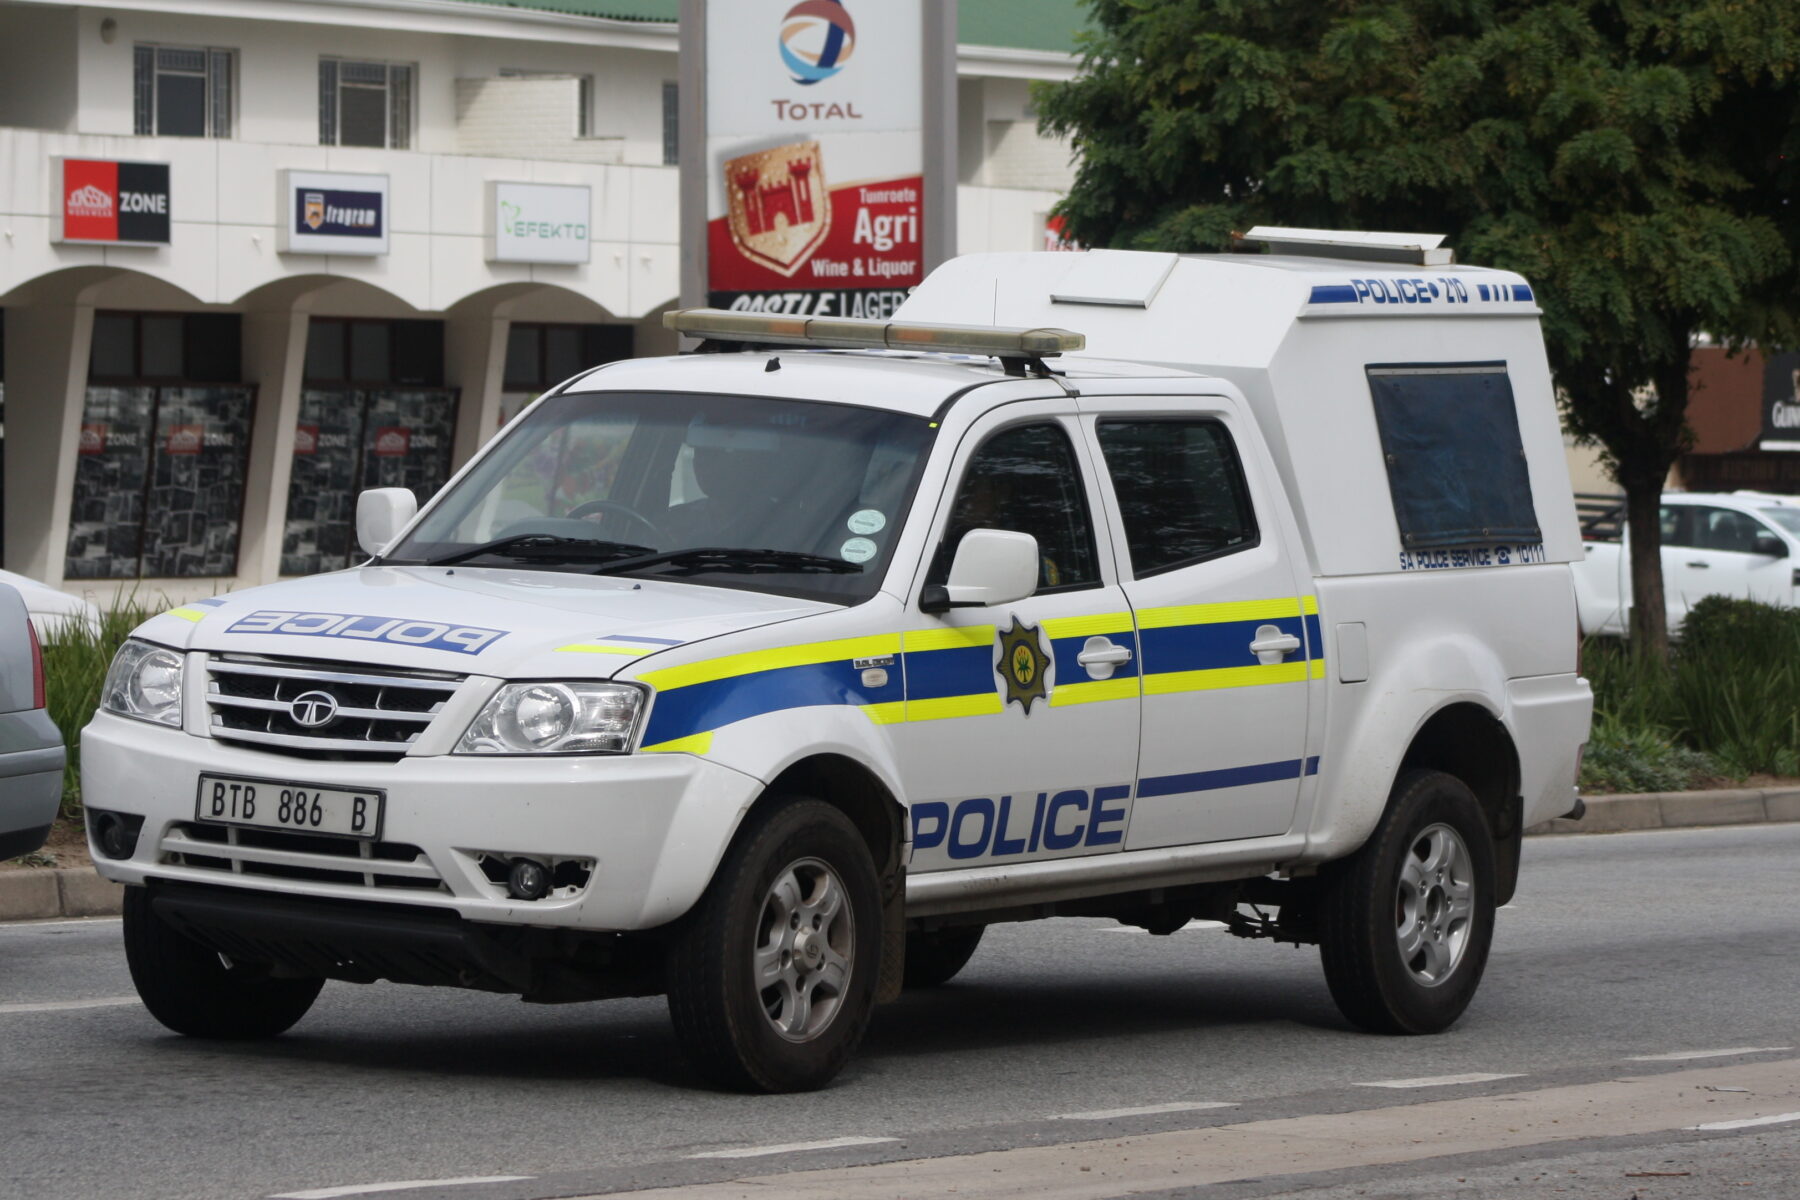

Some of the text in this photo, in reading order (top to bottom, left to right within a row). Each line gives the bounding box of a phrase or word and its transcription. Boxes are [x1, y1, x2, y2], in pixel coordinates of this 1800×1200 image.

[771, 99, 863, 120] TOTAL
[119, 192, 167, 214] ZONE
[514, 221, 587, 240] EFEKTO
[853, 206, 917, 251] Agri
[811, 257, 917, 279] Wine & Liquor
[1350, 278, 1432, 304] POLICE
[1399, 544, 1546, 570] SA POLICE SERVICE 10111
[212, 782, 367, 831] BTB 886 B
[910, 784, 1131, 863] POLICE
